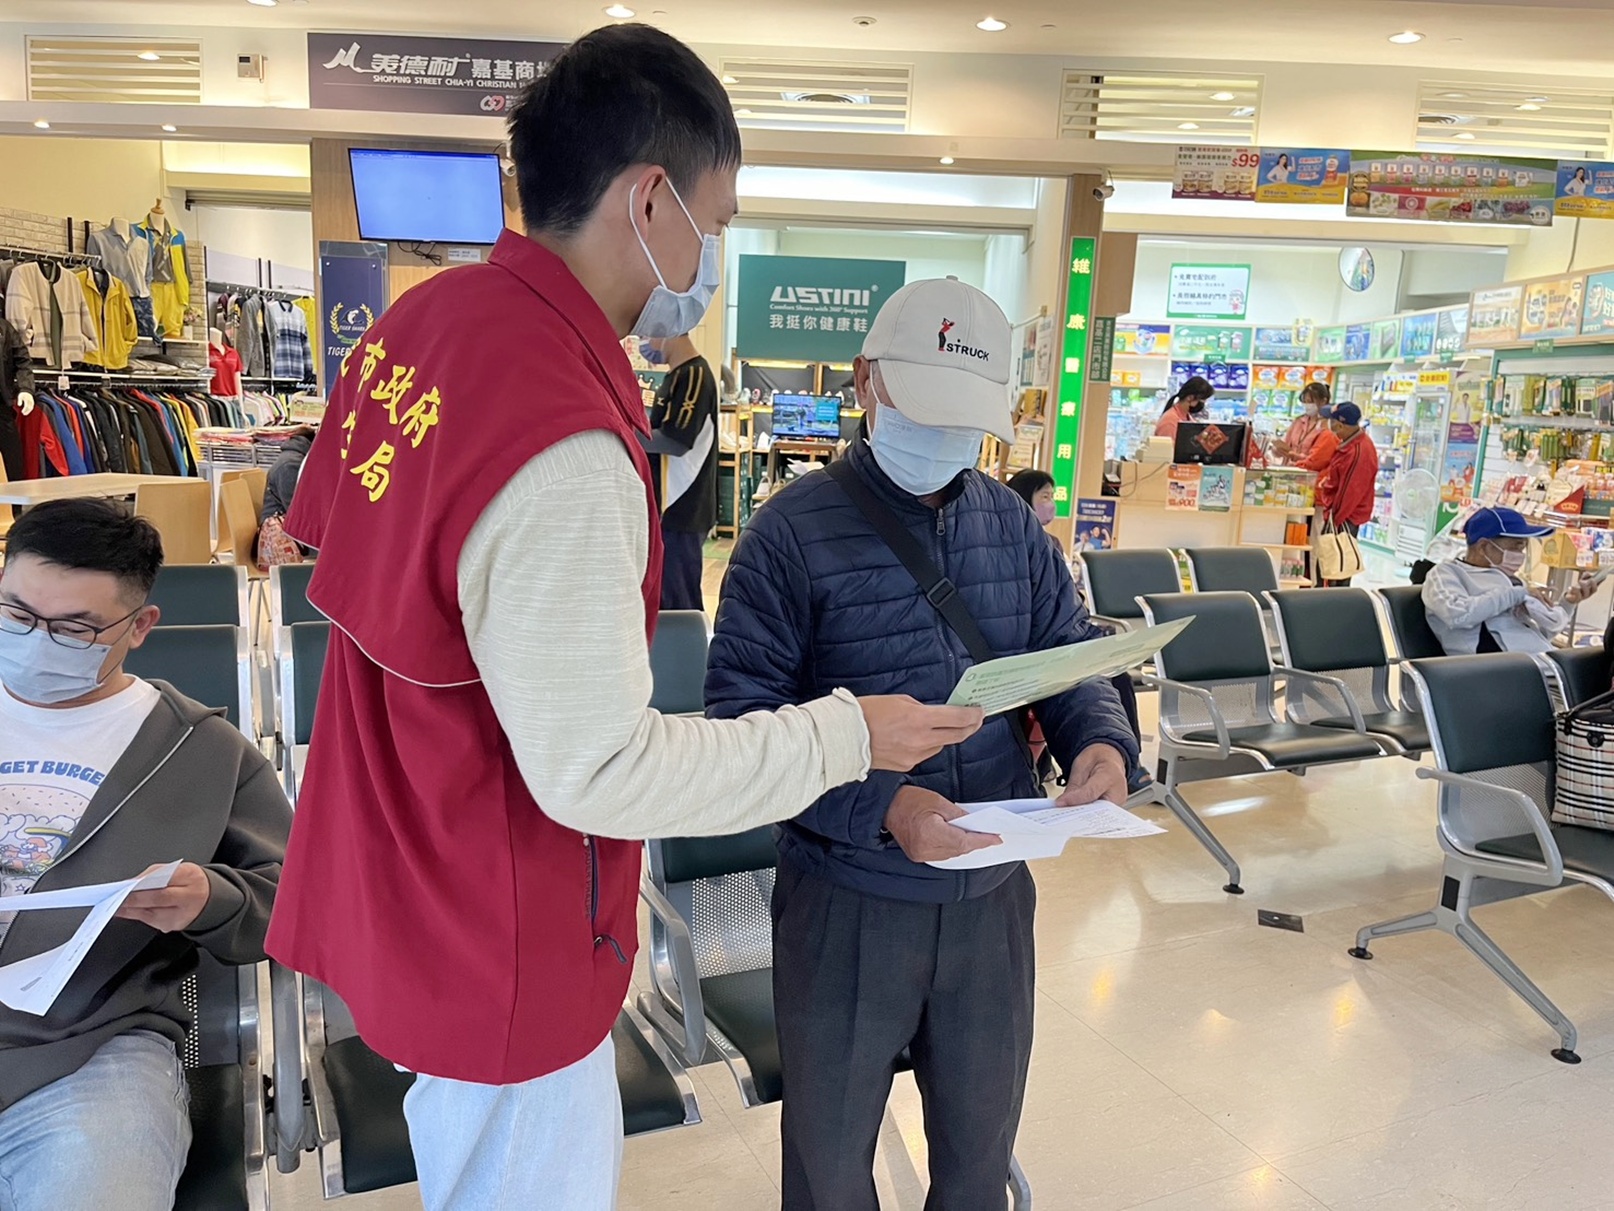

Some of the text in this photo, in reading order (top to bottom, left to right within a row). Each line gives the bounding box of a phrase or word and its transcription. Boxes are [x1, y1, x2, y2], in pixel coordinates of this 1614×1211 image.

[373, 75, 411, 84] SHOPPING
[414, 76, 442, 85] STREET
[445, 78, 474, 87] CHIA-YI
[476, 80, 517, 89] CHRISTIAN
[843, 307, 868, 315] Support
[769, 313, 868, 332] 我挺你健康鞋
[946, 342, 990, 361] STRUCK
[0, 760, 39, 774] GET
